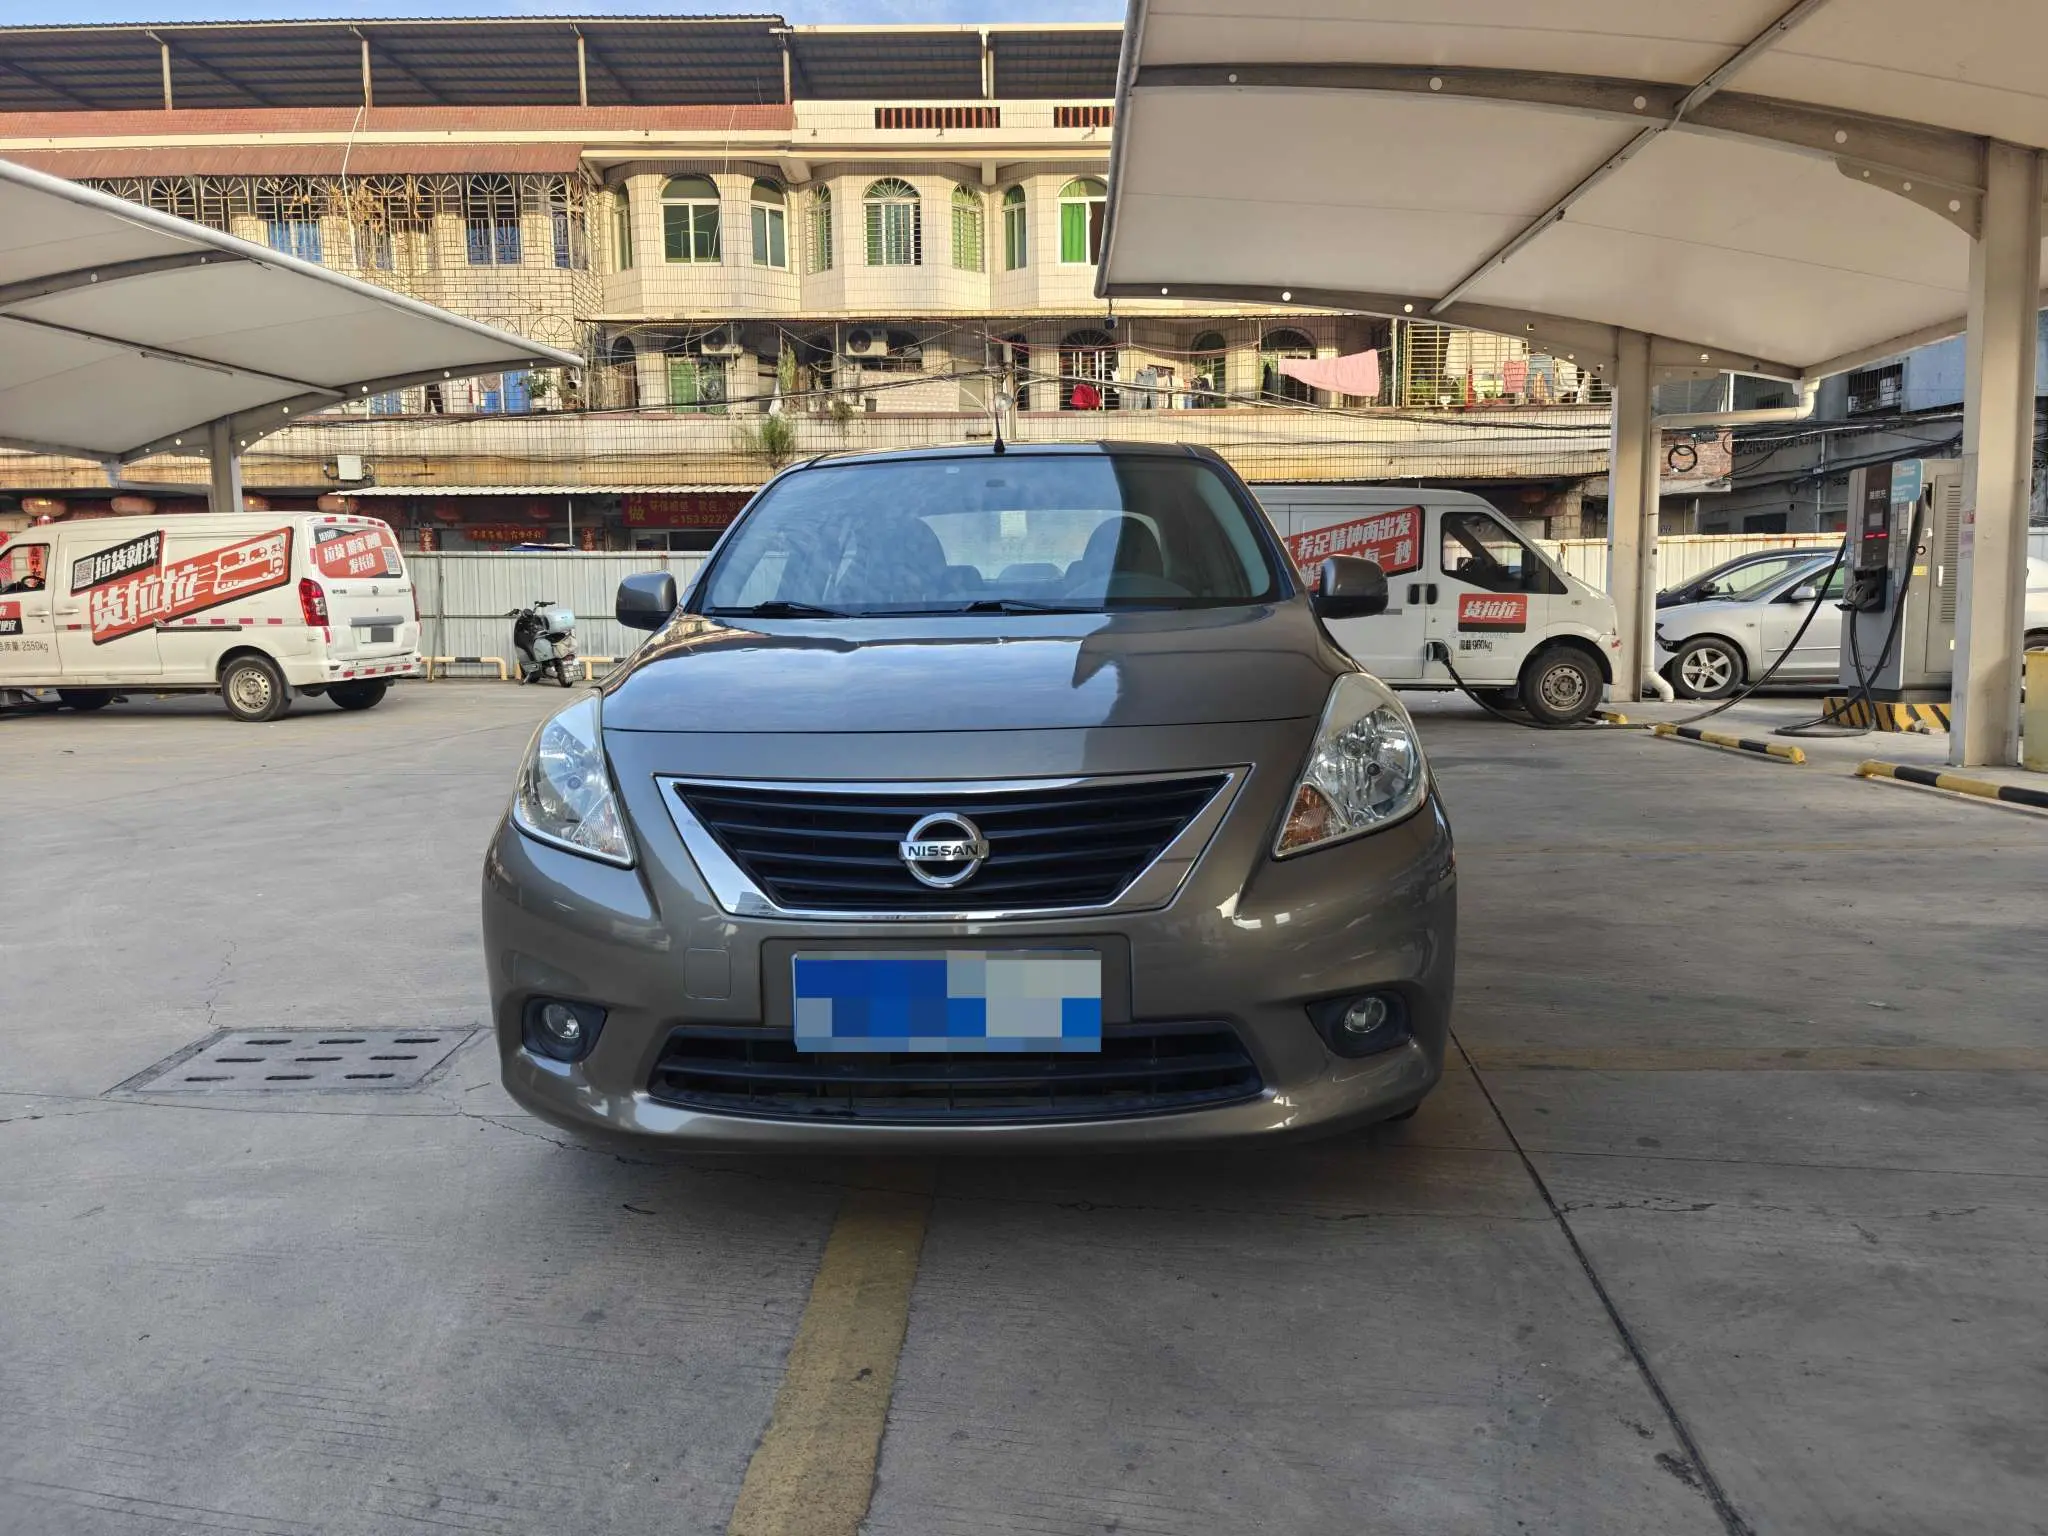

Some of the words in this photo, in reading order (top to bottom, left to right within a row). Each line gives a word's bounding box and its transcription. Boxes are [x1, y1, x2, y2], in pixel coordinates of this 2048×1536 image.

[95, 536, 159, 581] 拉货就找
[1298, 513, 1411, 560] 养足精神再出发
[91, 564, 198, 633] 货拉拉
[1462, 601, 1519, 620] 货拉拉
[908, 844, 978, 857] NISSAN
